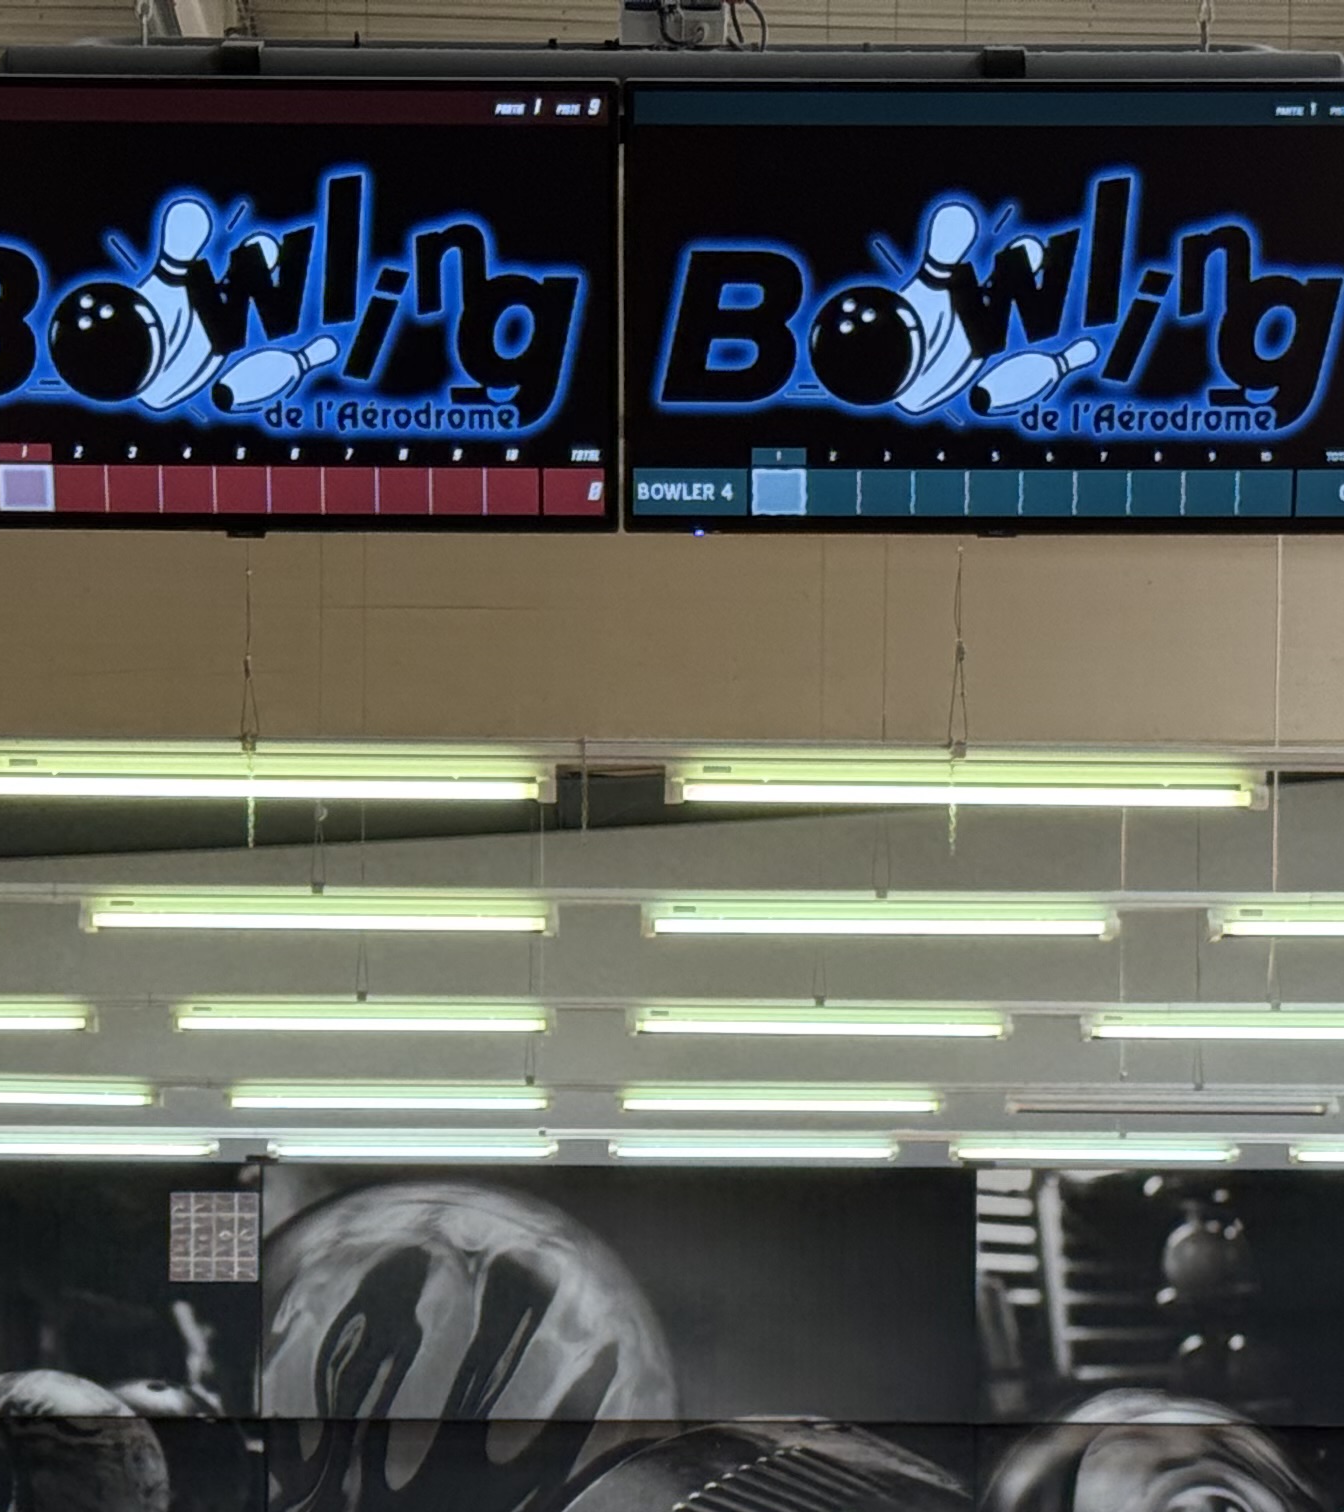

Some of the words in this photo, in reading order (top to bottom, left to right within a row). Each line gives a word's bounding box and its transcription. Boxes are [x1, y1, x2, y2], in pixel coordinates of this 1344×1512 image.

[534, 98, 542, 115] 1
[588, 98, 601, 115] 9
[1310, 102, 1317, 116] 1
[661, 175, 1344, 428] Bowling
[264, 399, 304, 430] de
[1020, 402, 1060, 432] de
[20, 445, 28, 458] 1
[73, 446, 84, 459] 2
[127, 446, 138, 459] 3
[181, 447, 192, 459] 4
[235, 447, 246, 460] 5
[290, 447, 301, 461] 6
[345, 448, 354, 461] 7
[398, 448, 409, 461] 8
[452, 449, 463, 461] 9
[505, 448, 520, 462] 10
[829, 450, 839, 462] 2
[884, 451, 892, 462] 3
[937, 451, 946, 462] 4
[991, 451, 1001, 462] 5
[1046, 451, 1055, 463] 6
[1100, 451, 1109, 463] 7
[1153, 451, 1163, 463] 8
[1208, 451, 1217, 463] 9
[1260, 451, 1274, 463] 10
[637, 482, 716, 501] BOWLER
[720, 483, 734, 501] 4
